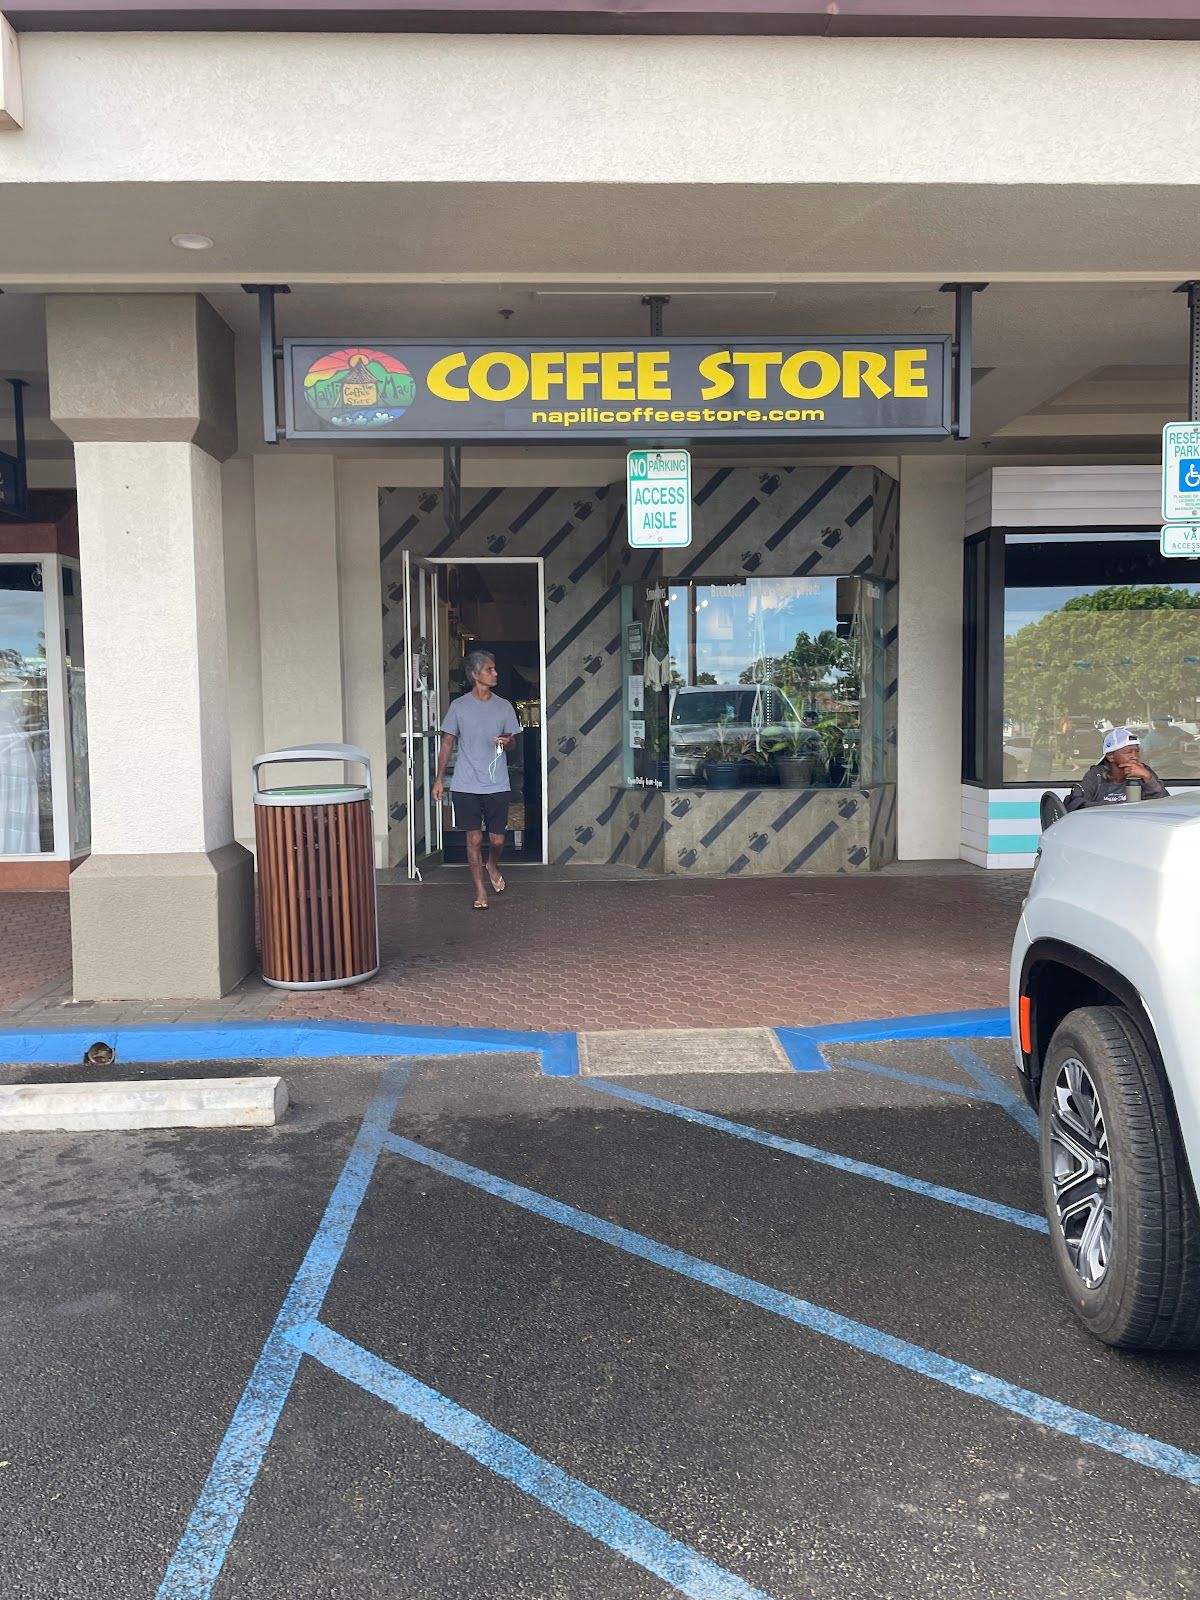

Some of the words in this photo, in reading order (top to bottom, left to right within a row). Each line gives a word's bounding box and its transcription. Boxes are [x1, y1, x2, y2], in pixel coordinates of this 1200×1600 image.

[427, 350, 672, 402] COFFEE
[699, 349, 929, 401] STORE
[382, 376, 416, 399] Maui
[531, 407, 825, 425] napilicoffeestore.com
[630, 459, 646, 477] NO
[649, 460, 686, 471] PARKING
[634, 486, 685, 505] ACCESS
[643, 512, 677, 529] AISLE
